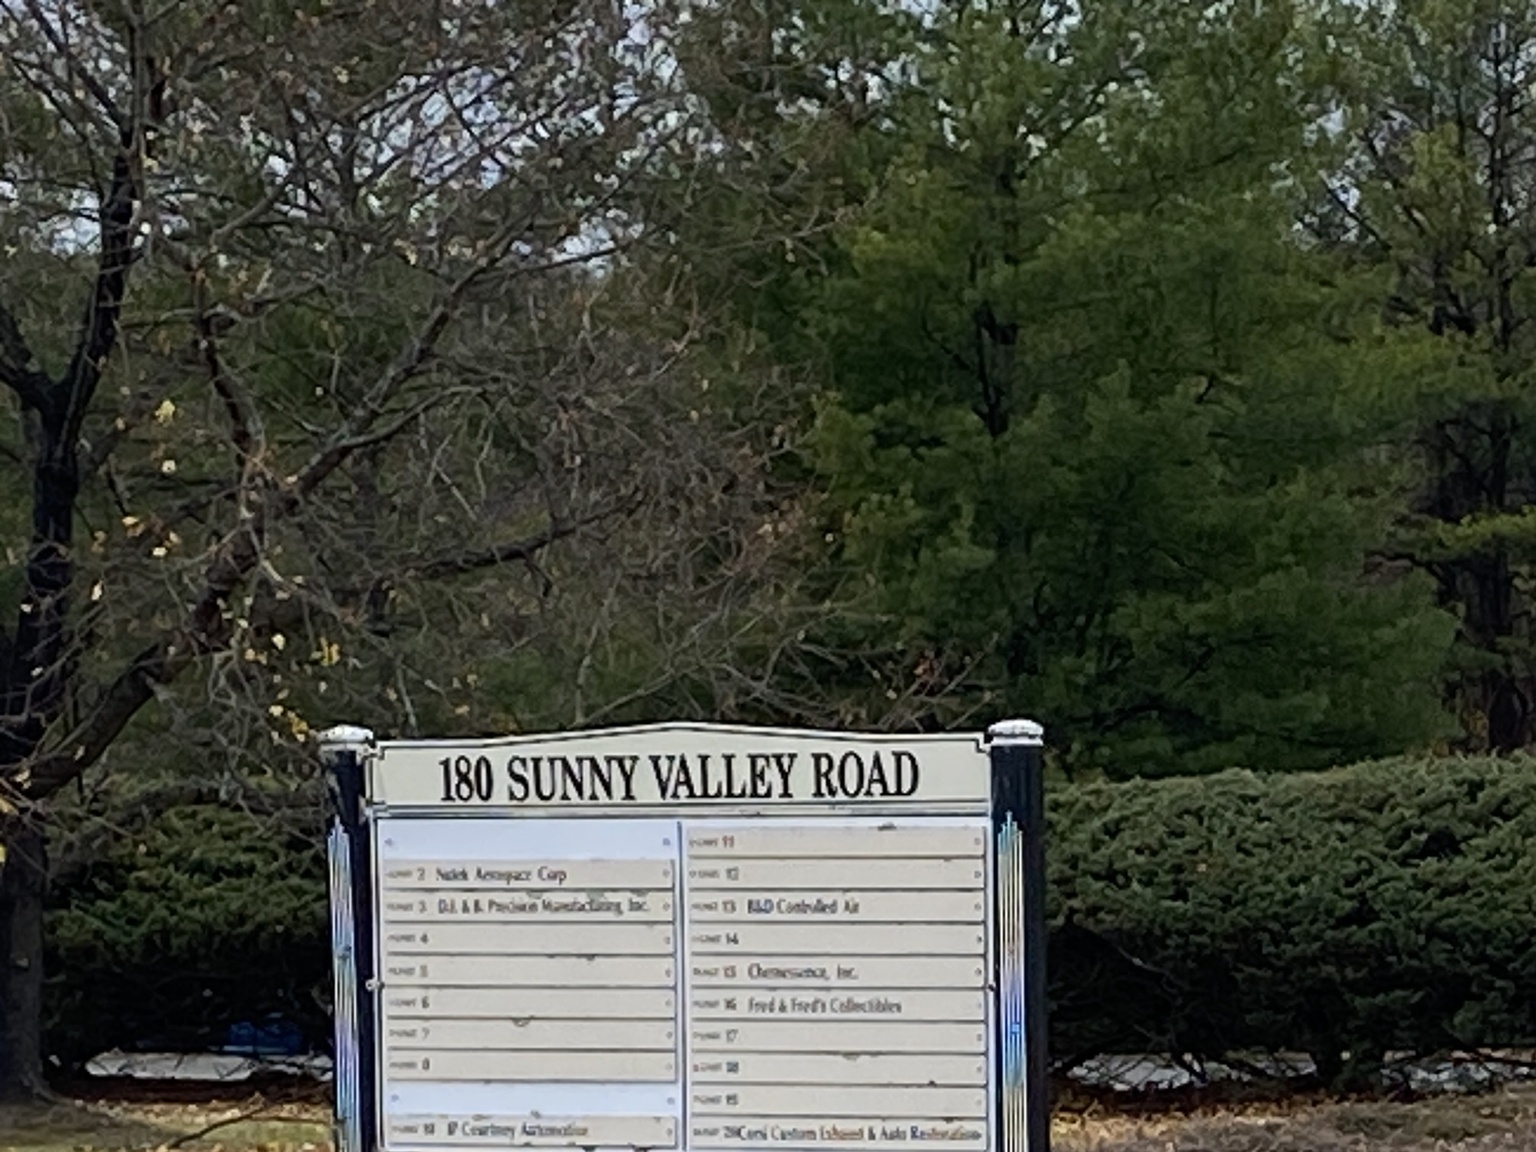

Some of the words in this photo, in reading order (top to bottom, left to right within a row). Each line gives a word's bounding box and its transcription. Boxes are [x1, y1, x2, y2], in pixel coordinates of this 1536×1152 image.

[438, 756, 494, 801] 180
[507, 756, 639, 801] SUNNY
[648, 752, 797, 800] VALLEY
[812, 750, 920, 798] ROAD
[538, 866, 567, 886] Corp
[488, 899, 538, 914] Precision
[627, 898, 652, 912] Inc.
[776, 898, 838, 915] Controlled
[844, 900, 860, 914] Air
[837, 964, 859, 980] Inc.
[748, 998, 776, 1013] Fred
[779, 999, 788, 1012] &
[791, 997, 827, 1014] Fred's
[830, 998, 903, 1014] Collectibles
[462, 1122, 516, 1140] Courtney
[770, 1125, 818, 1141] Custom
[880, 1126, 907, 1142] Auto
